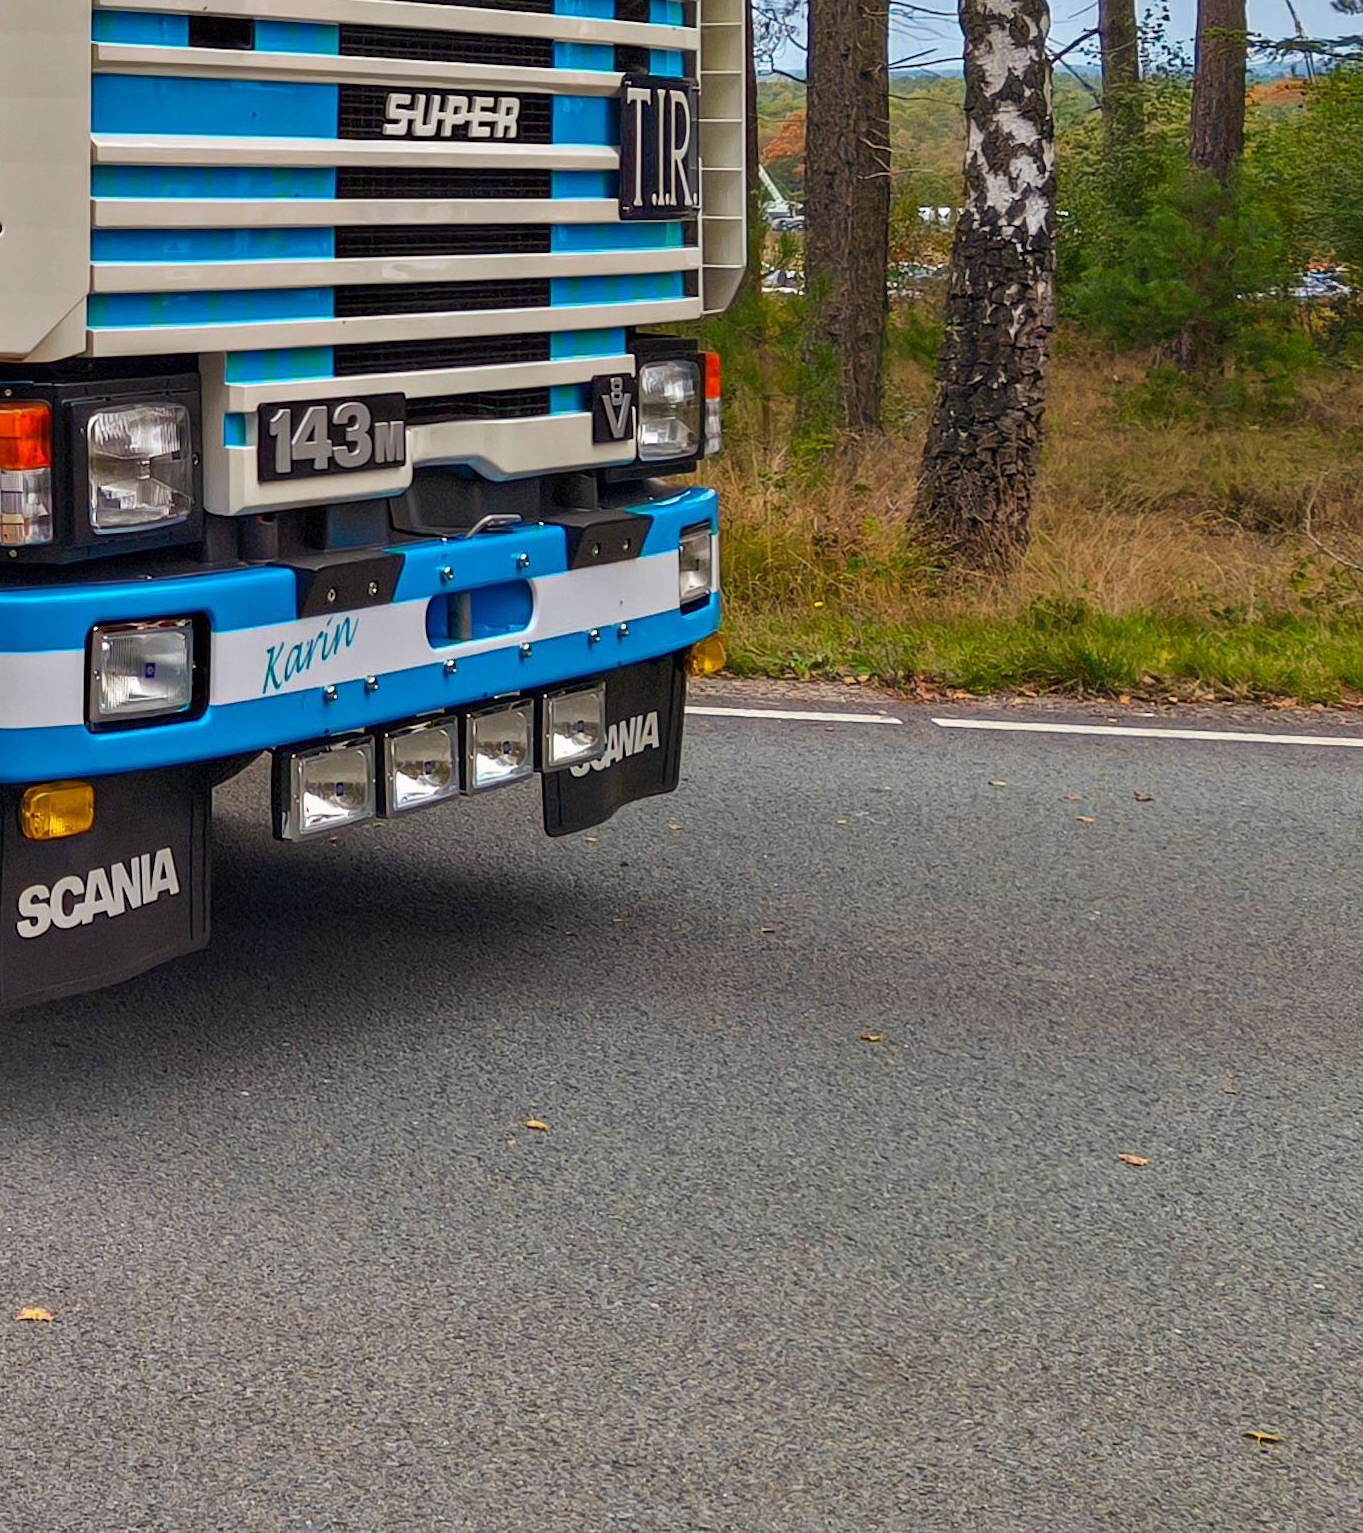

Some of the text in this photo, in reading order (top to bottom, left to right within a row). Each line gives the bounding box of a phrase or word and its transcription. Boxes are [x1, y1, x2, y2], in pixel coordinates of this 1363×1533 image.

[382, 92, 521, 139] SUPER
[262, 616, 360, 695] Karin
[569, 710, 661, 778] ANIA
[16, 846, 181, 939] SCANIA
